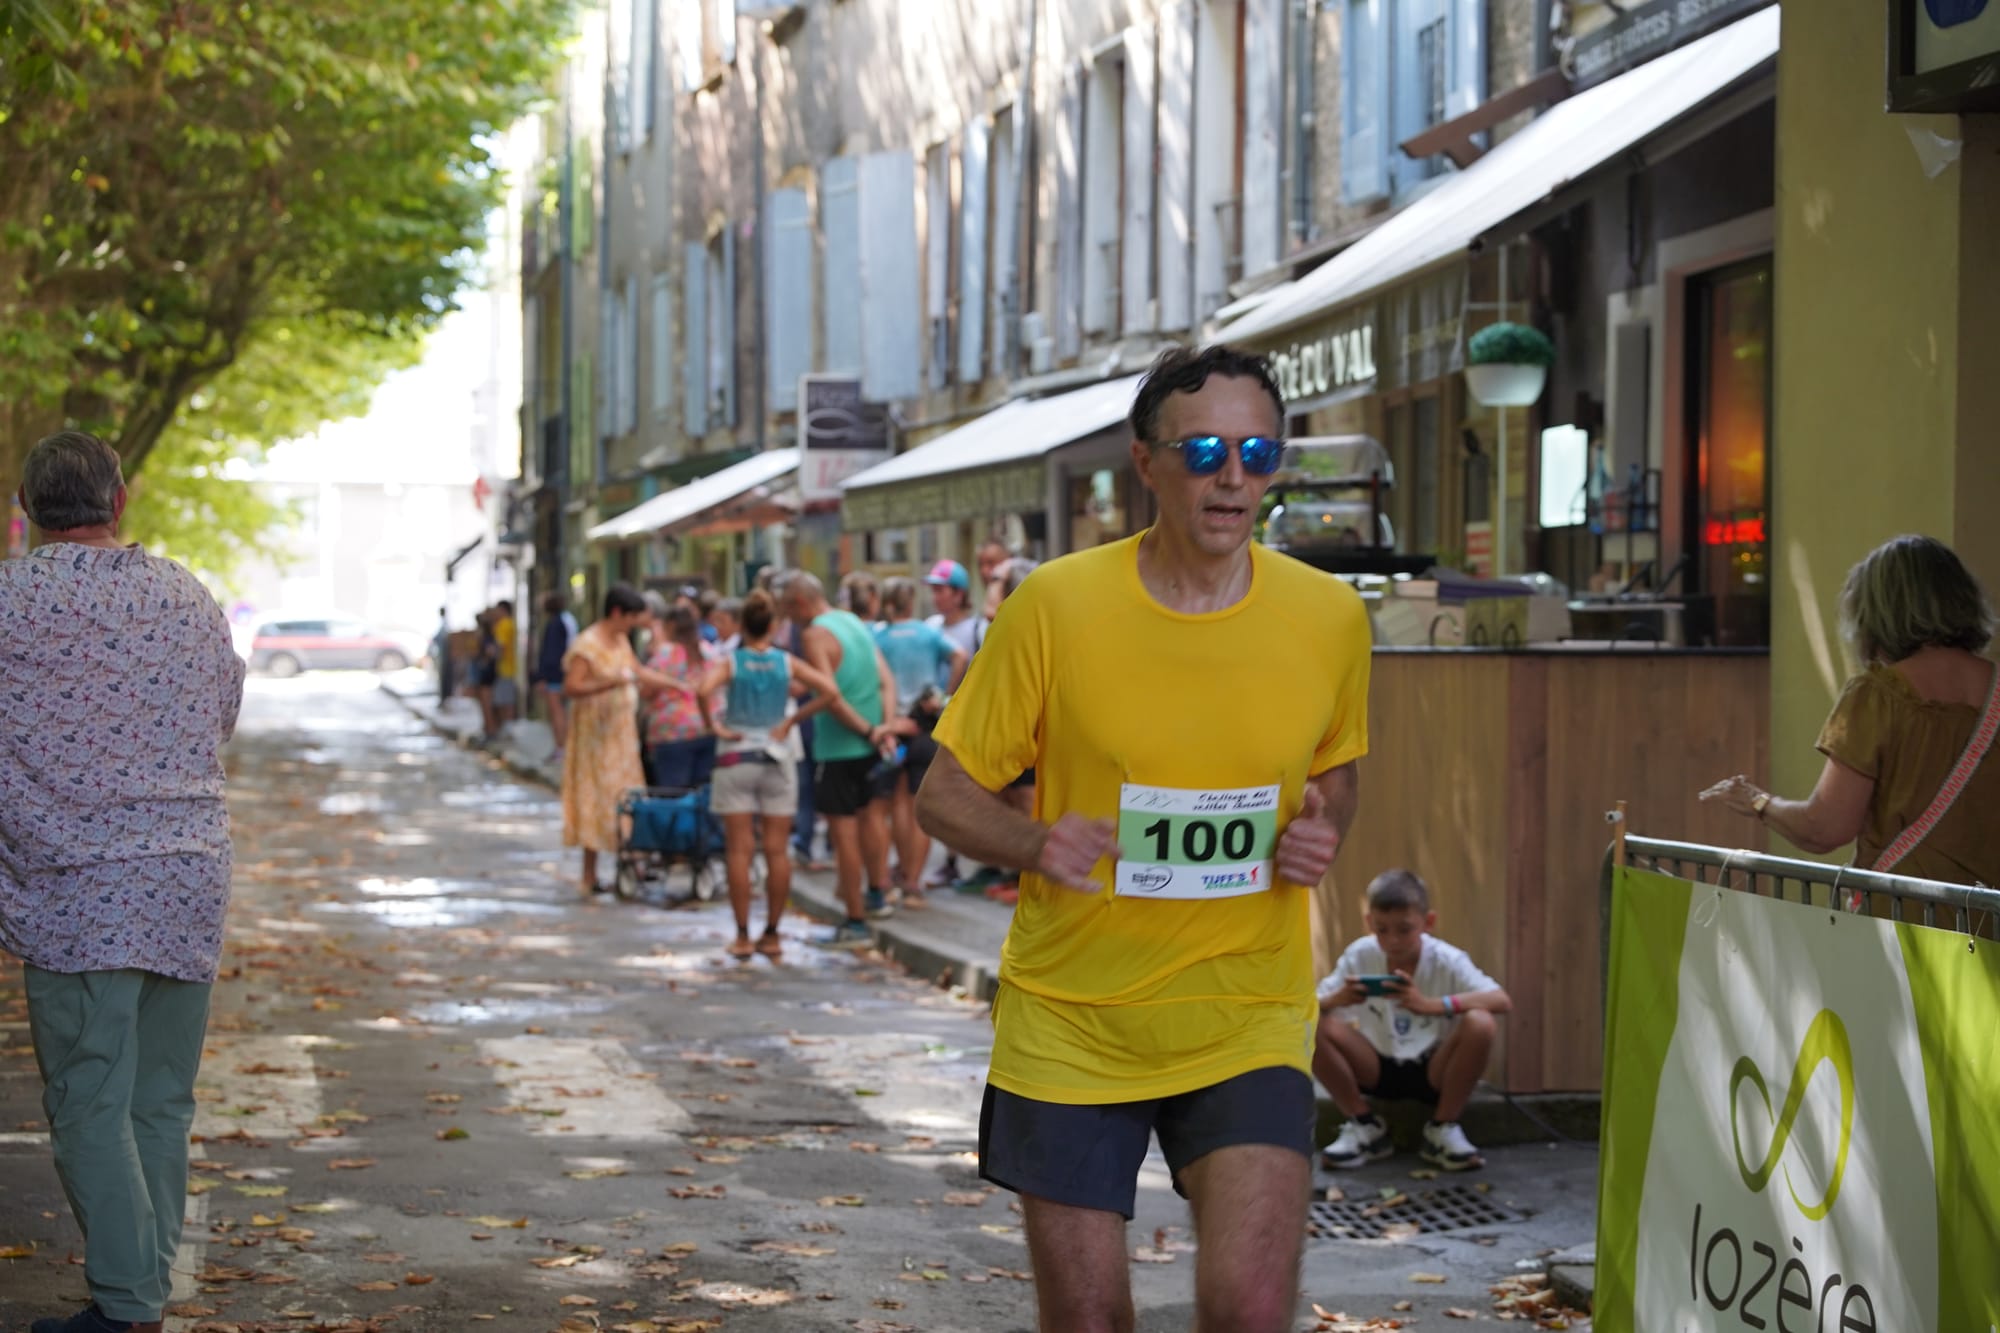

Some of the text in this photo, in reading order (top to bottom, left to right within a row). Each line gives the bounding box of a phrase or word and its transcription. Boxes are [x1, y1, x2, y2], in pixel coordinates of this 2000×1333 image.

[1331, 325, 1377, 386] VAL
[1144, 818, 1255, 862] 100
[1690, 1203, 1877, 1333] lozère
